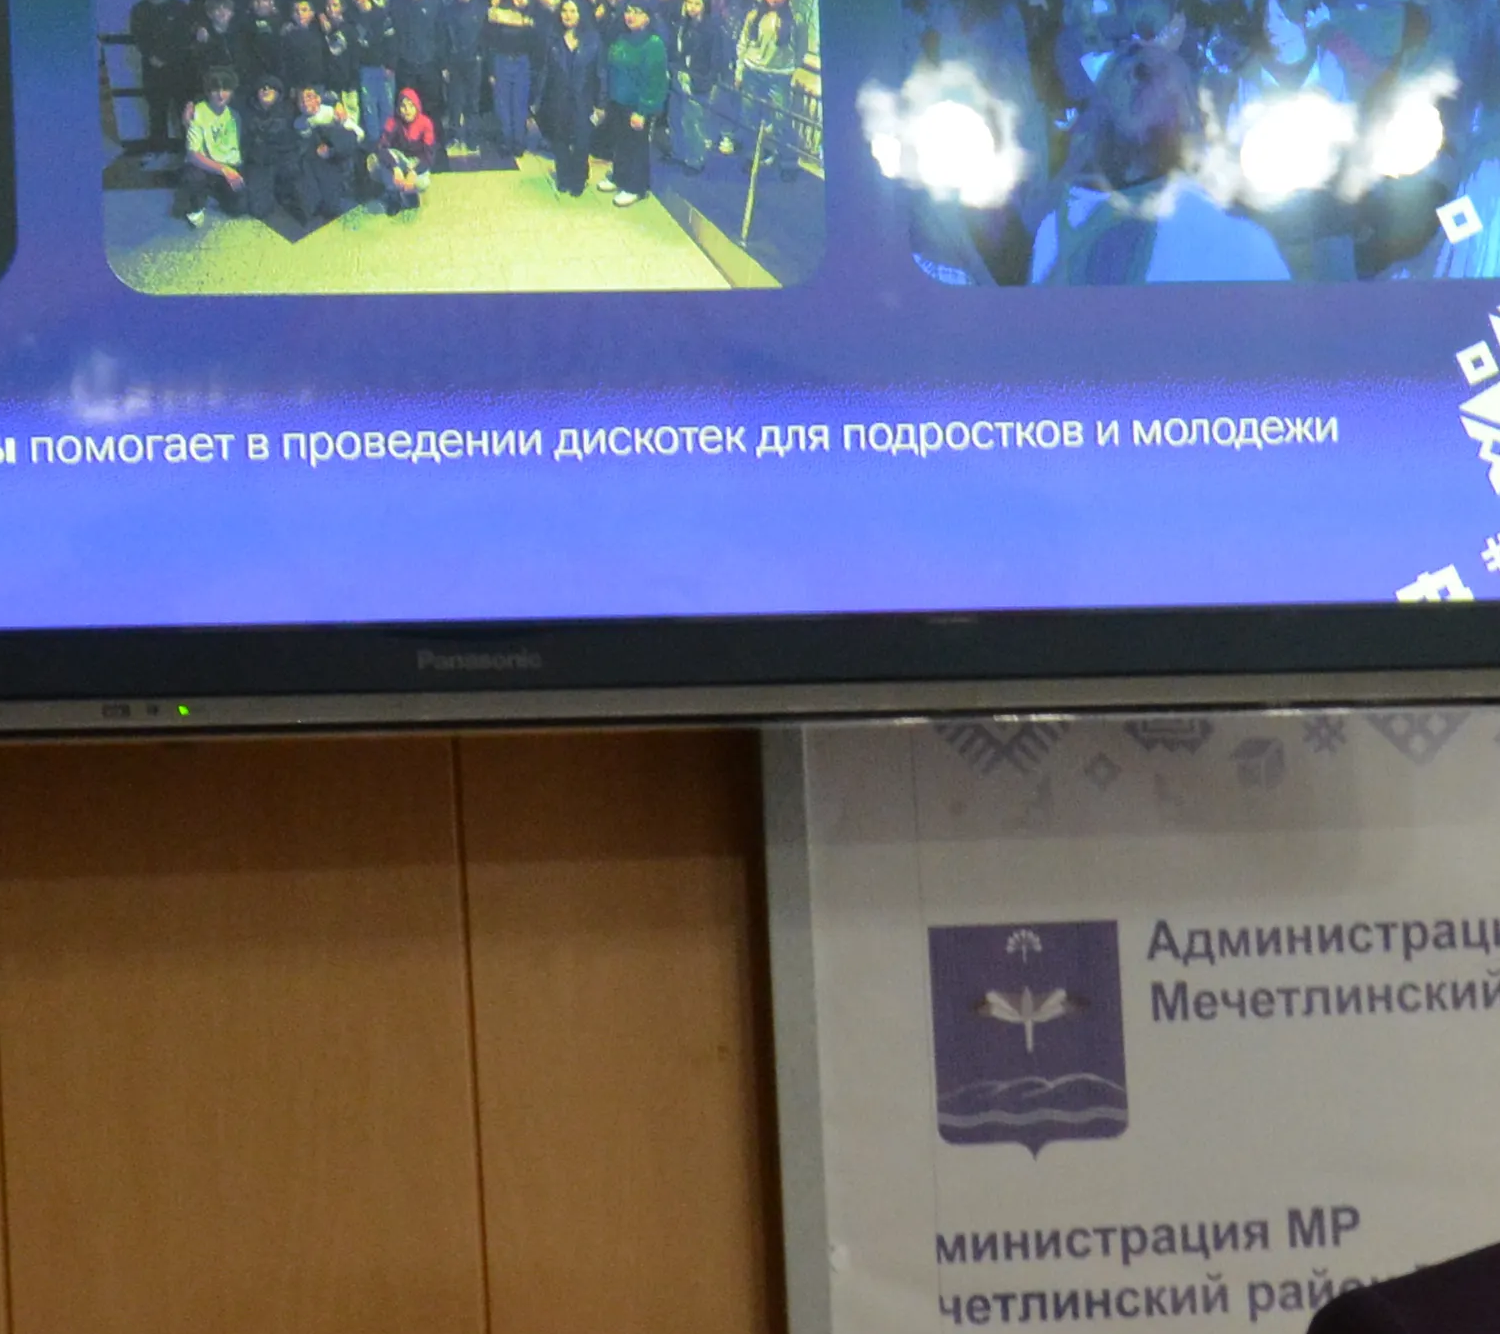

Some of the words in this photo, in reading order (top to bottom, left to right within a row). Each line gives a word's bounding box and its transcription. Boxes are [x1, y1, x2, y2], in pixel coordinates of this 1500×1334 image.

[31, 433, 234, 464] помогает
[248, 434, 269, 460] в
[283, 430, 542, 468] проведении
[554, 426, 746, 461] дискотек
[756, 425, 829, 458] для
[844, 420, 1084, 458] подростков
[1097, 420, 1119, 446] и
[1133, 416, 1338, 450] молодежи
[1288, 1205, 1362, 1249] МР
